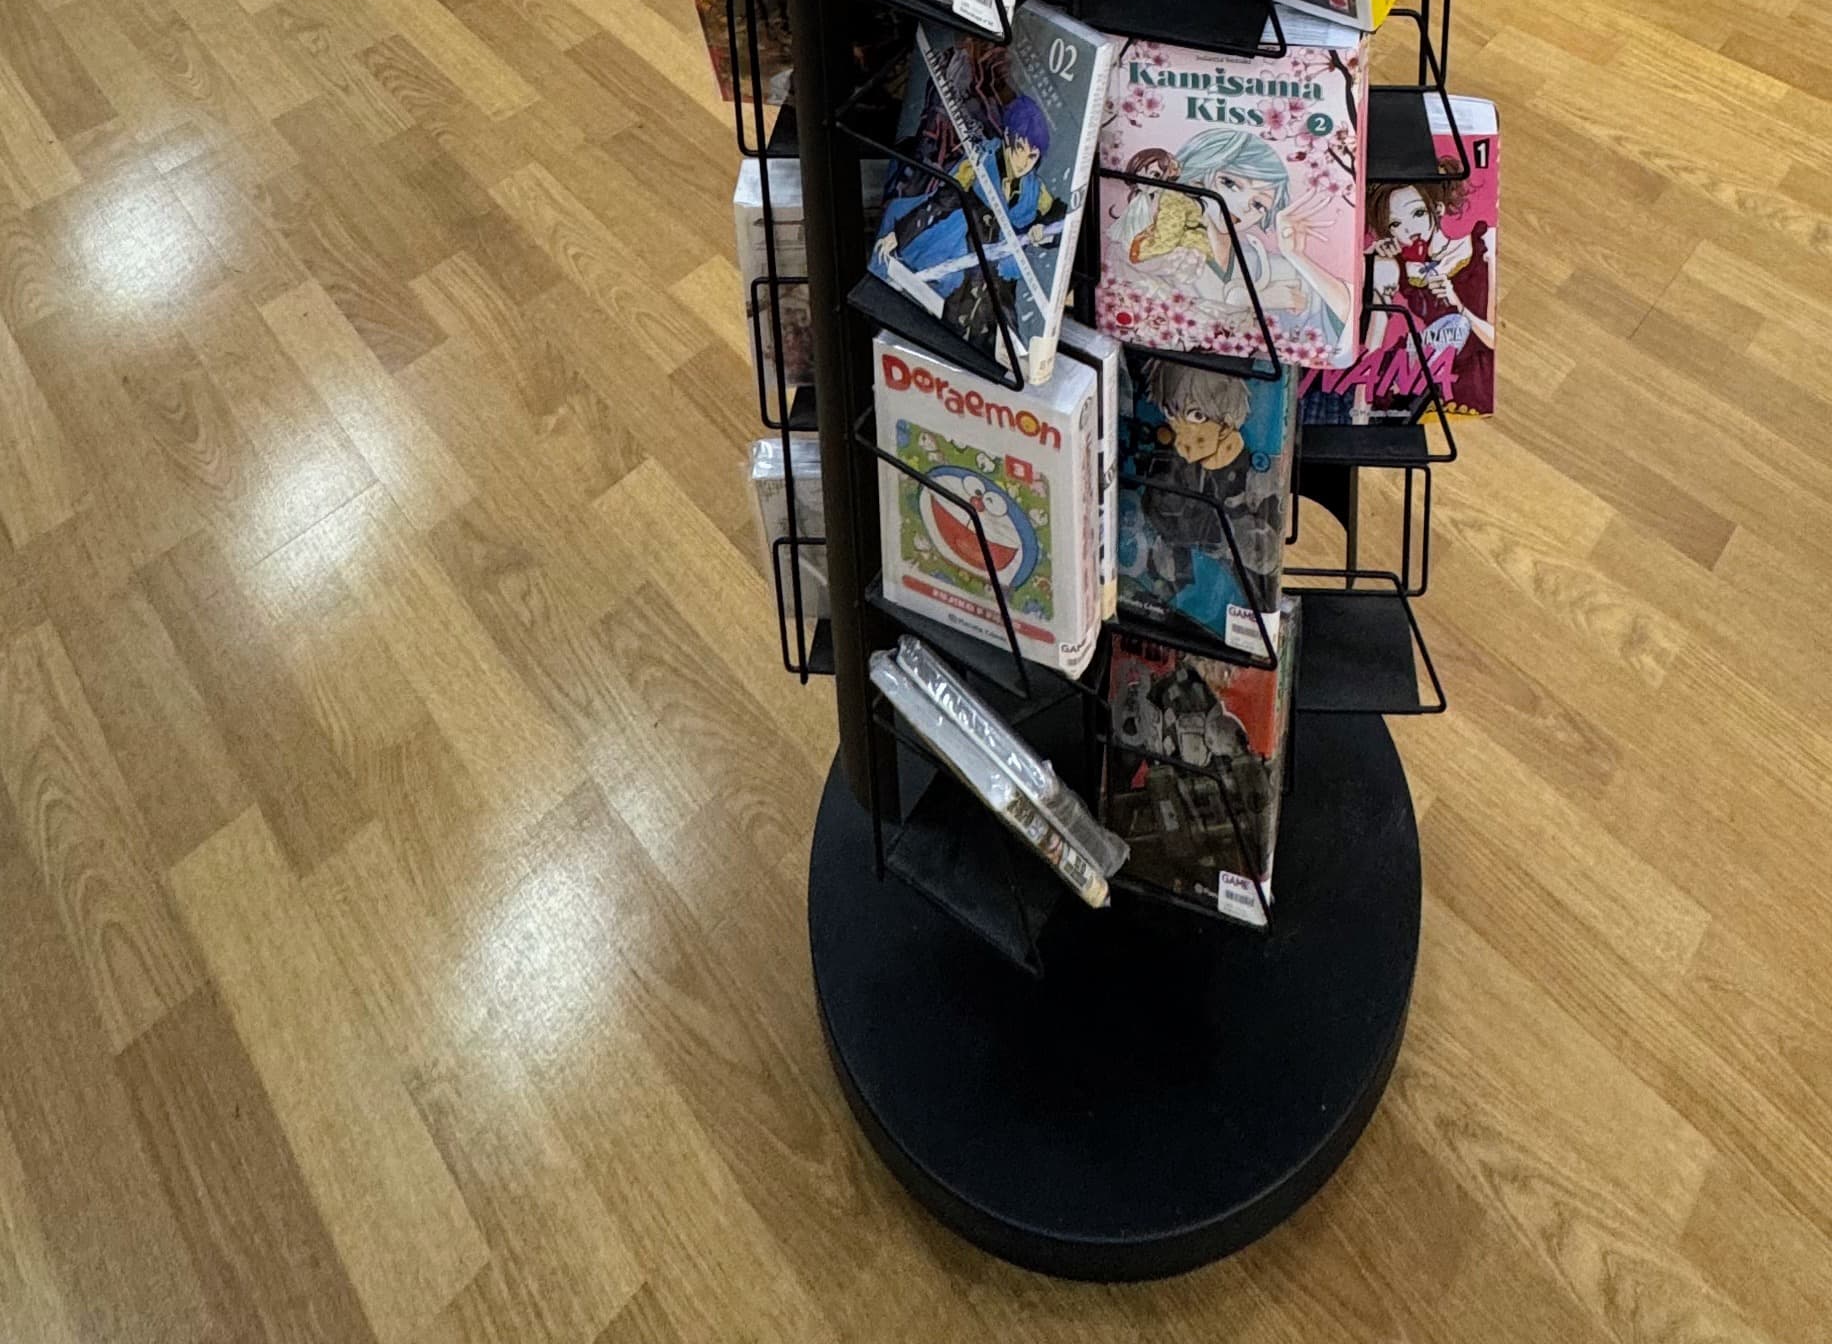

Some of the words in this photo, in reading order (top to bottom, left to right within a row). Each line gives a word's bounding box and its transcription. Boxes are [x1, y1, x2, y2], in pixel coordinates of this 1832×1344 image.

[1049, 37, 1078, 82] 02
[1129, 62, 1324, 101] Kamisama
[1186, 96, 1265, 126] Kiss
[1313, 116, 1327, 132] 2
[1476, 140, 1488, 167] 1
[1299, 343, 1460, 404] NANA
[882, 354, 1062, 451] Doraemon
[1229, 607, 1258, 622] GAME
[1222, 872, 1251, 890] GAME
